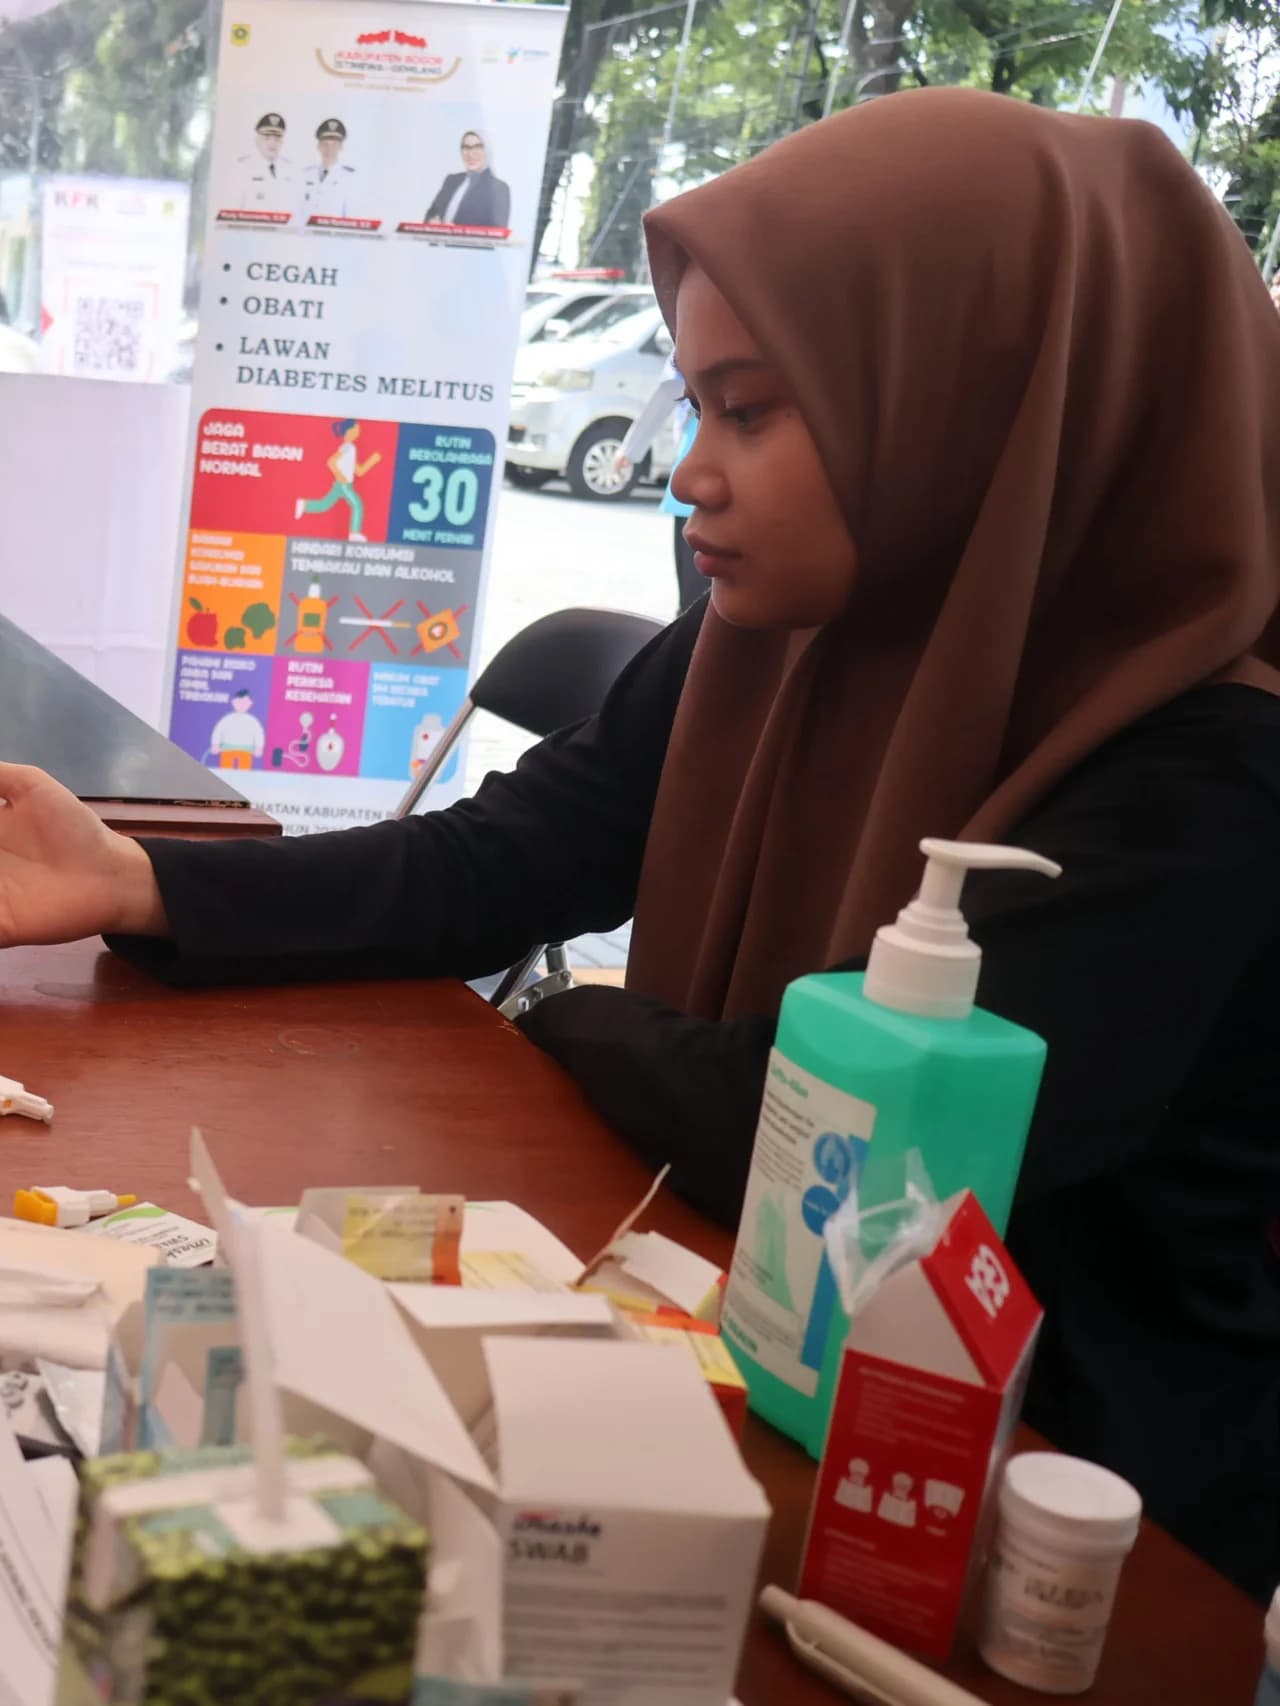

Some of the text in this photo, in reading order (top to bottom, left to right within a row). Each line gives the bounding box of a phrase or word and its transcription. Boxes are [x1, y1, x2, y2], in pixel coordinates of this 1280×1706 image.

[246, 262, 338, 286] CEGAH
[243, 295, 324, 319] OBATI
[239, 336, 330, 360] LAWAN
[236, 366, 494, 402] DIABETES MELITUS
[203, 421, 245, 438] JAGA
[201, 440, 304, 462] BERAT BADAN
[435, 435, 472, 449] RUTIN
[200, 458, 262, 478] NORMAL
[407, 464, 479, 527] 30
[363, 564, 392, 577] DAN
[394, 566, 456, 583] ALKOHOL
[287, 660, 324, 674] RUTIN
[303, 806, 382, 821] KABUPATEN
